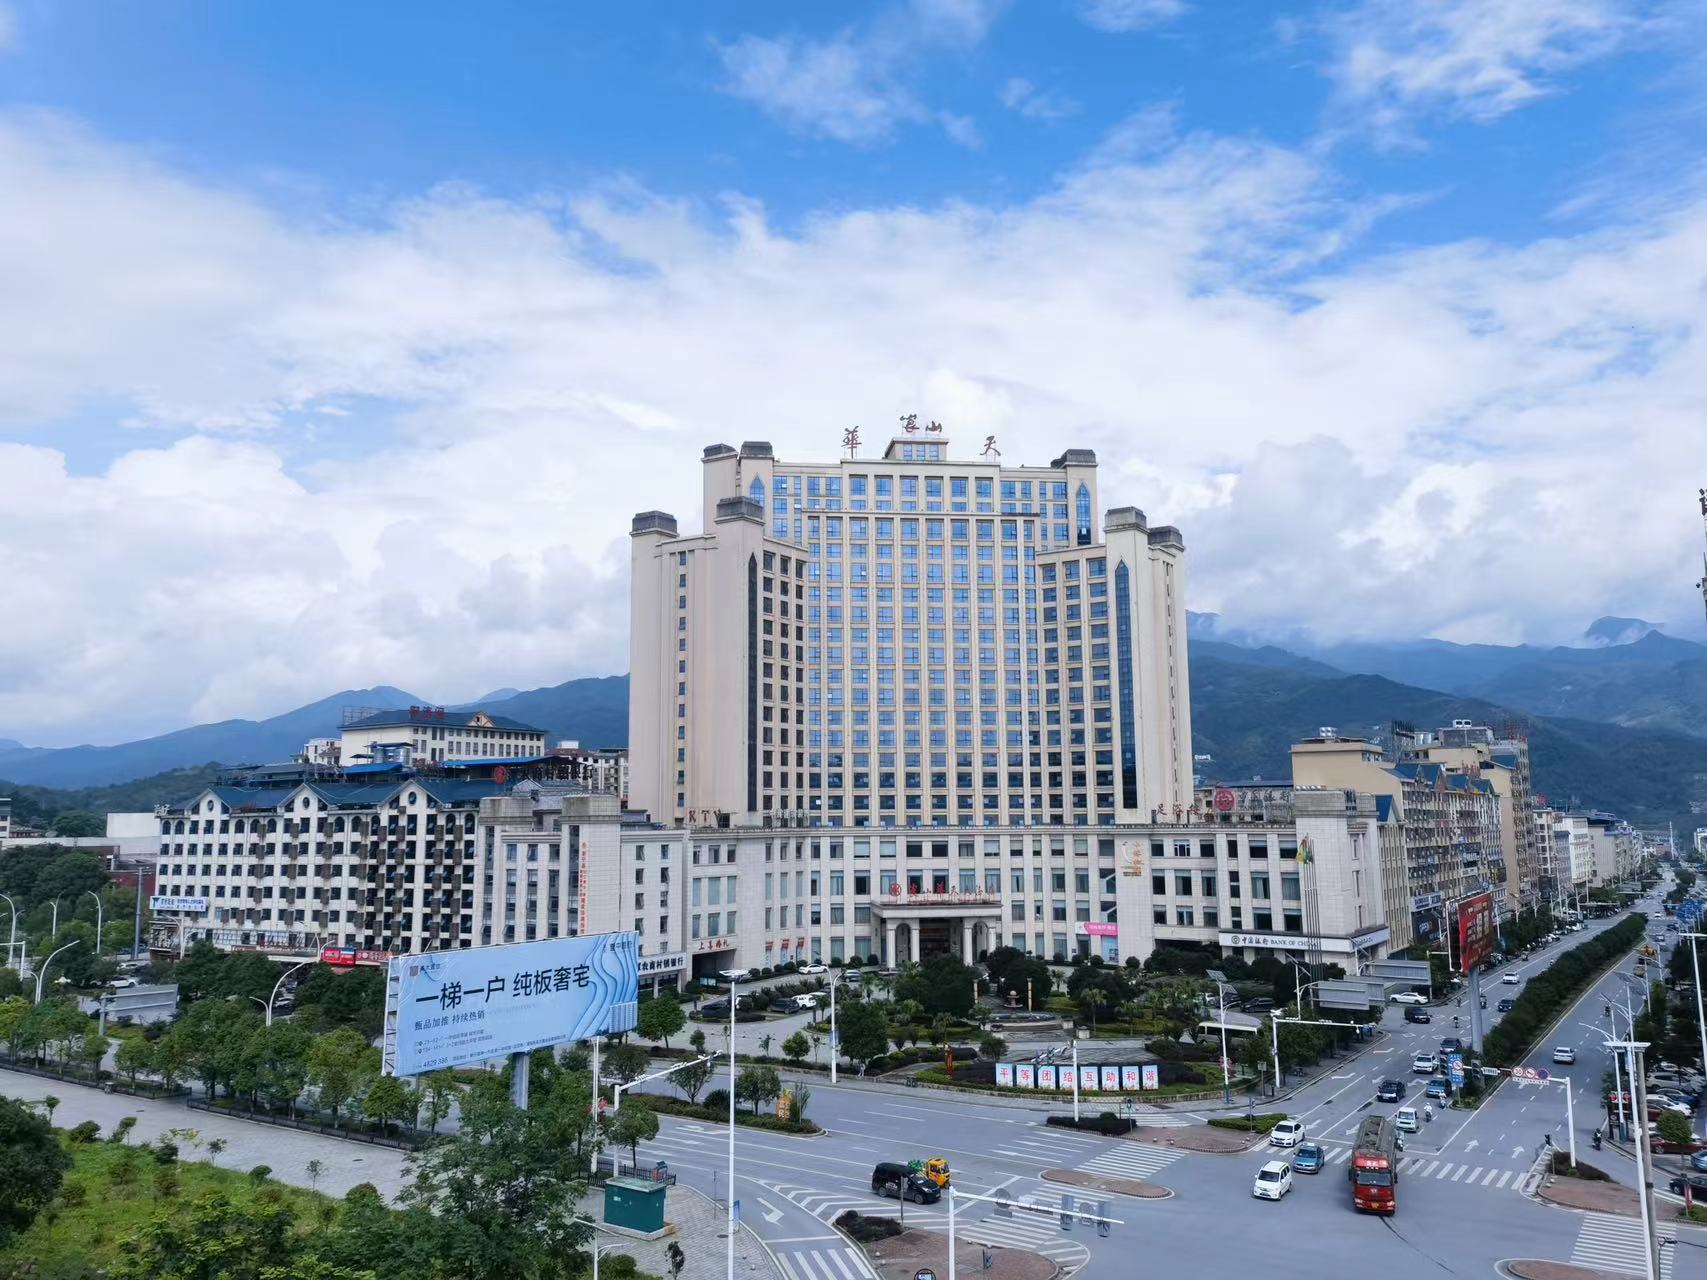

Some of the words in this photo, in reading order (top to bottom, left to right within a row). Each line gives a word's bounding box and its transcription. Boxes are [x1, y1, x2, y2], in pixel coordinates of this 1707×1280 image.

[688, 808, 722, 824] KTV
[1241, 936, 1269, 946] 中国银行
[415, 975, 506, 1011] 一梯一户
[512, 963, 590, 998] 纯板奢宅
[451, 1010, 485, 1024] 持续热销
